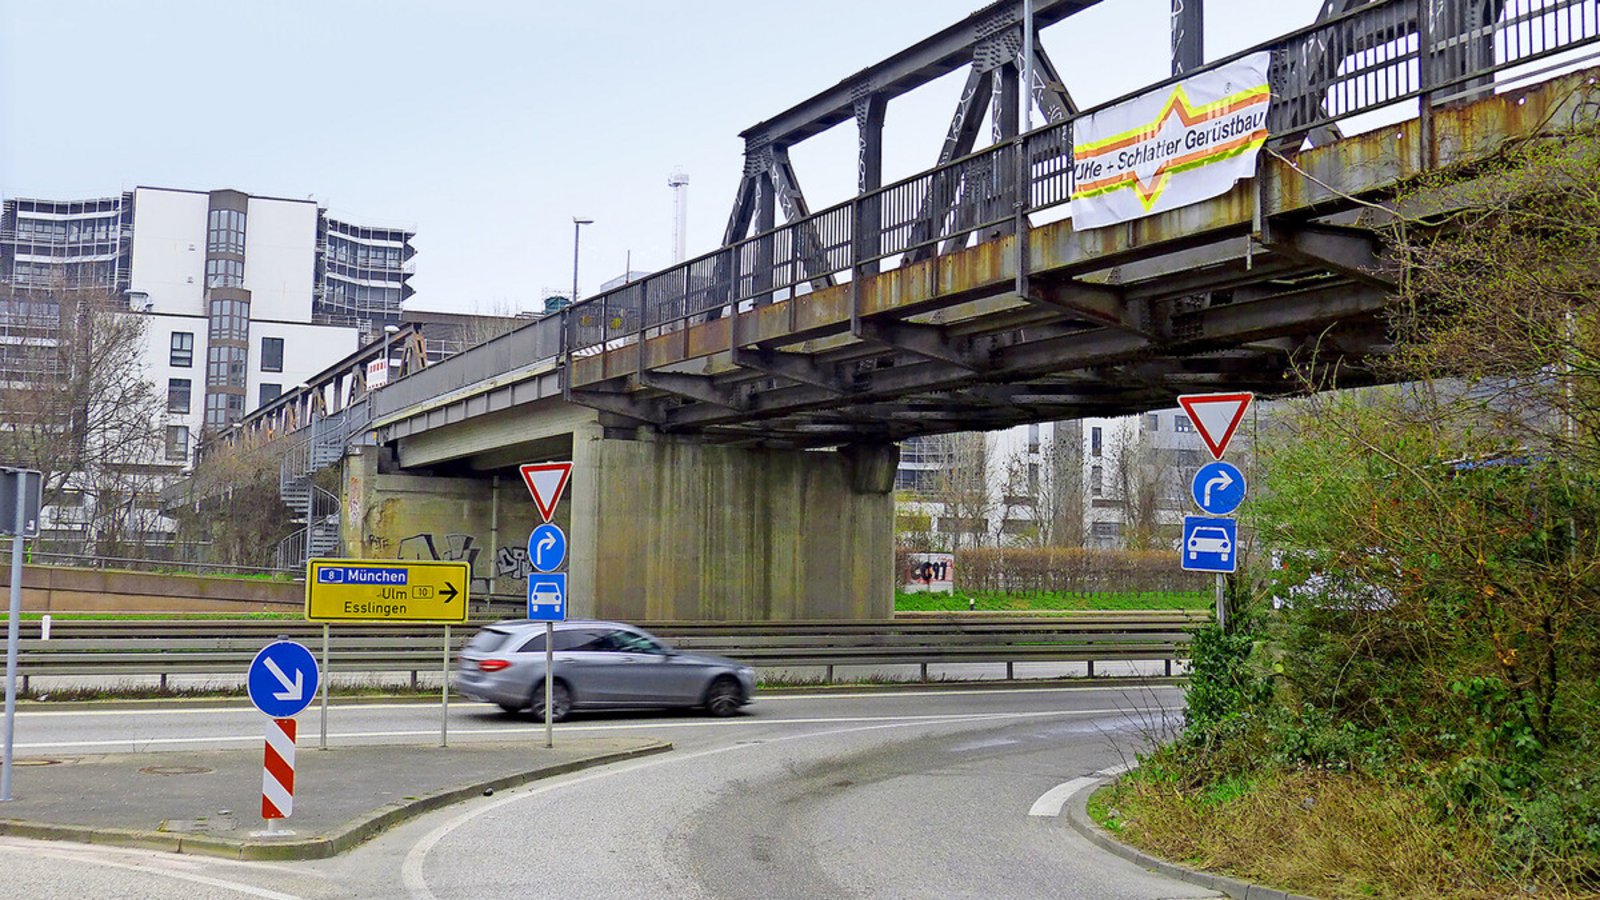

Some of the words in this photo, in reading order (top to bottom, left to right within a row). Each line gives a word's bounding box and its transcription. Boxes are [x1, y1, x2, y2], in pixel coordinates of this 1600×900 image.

[1117, 138, 1182, 170] Schlatter
[1184, 111, 1264, 150] Gerüstbau
[328, 570, 335, 580] 8
[347, 569, 406, 583] München
[382, 588, 408, 600] Ulm
[418, 587, 428, 597] 10
[344, 601, 407, 616] Esslingen
